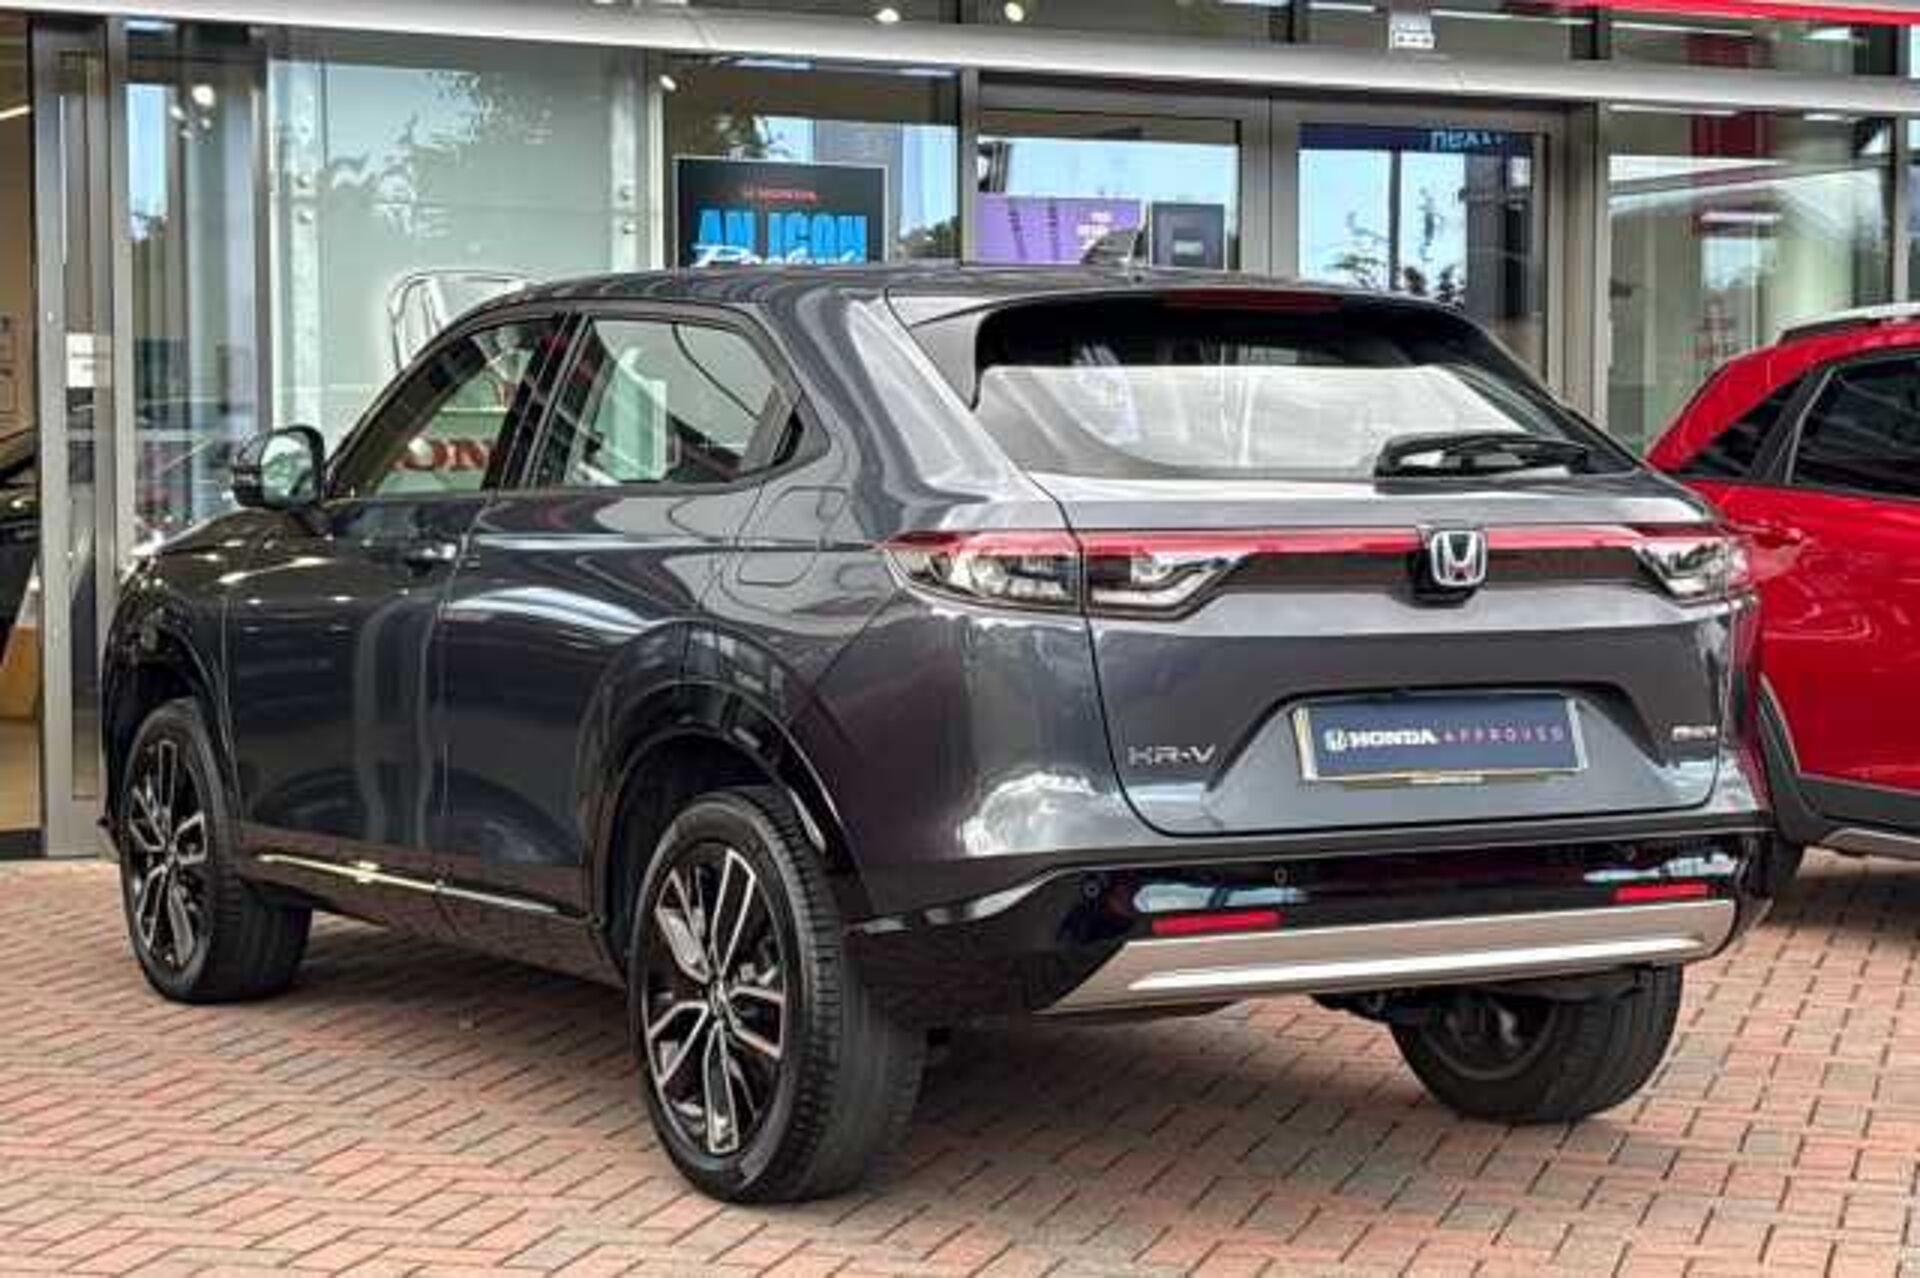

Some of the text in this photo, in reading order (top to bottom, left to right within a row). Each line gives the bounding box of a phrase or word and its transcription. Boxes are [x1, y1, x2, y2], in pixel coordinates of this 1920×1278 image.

[699, 208, 756, 248] AN
[767, 211, 867, 264] ICON
[1347, 729, 1440, 749] HONDA
